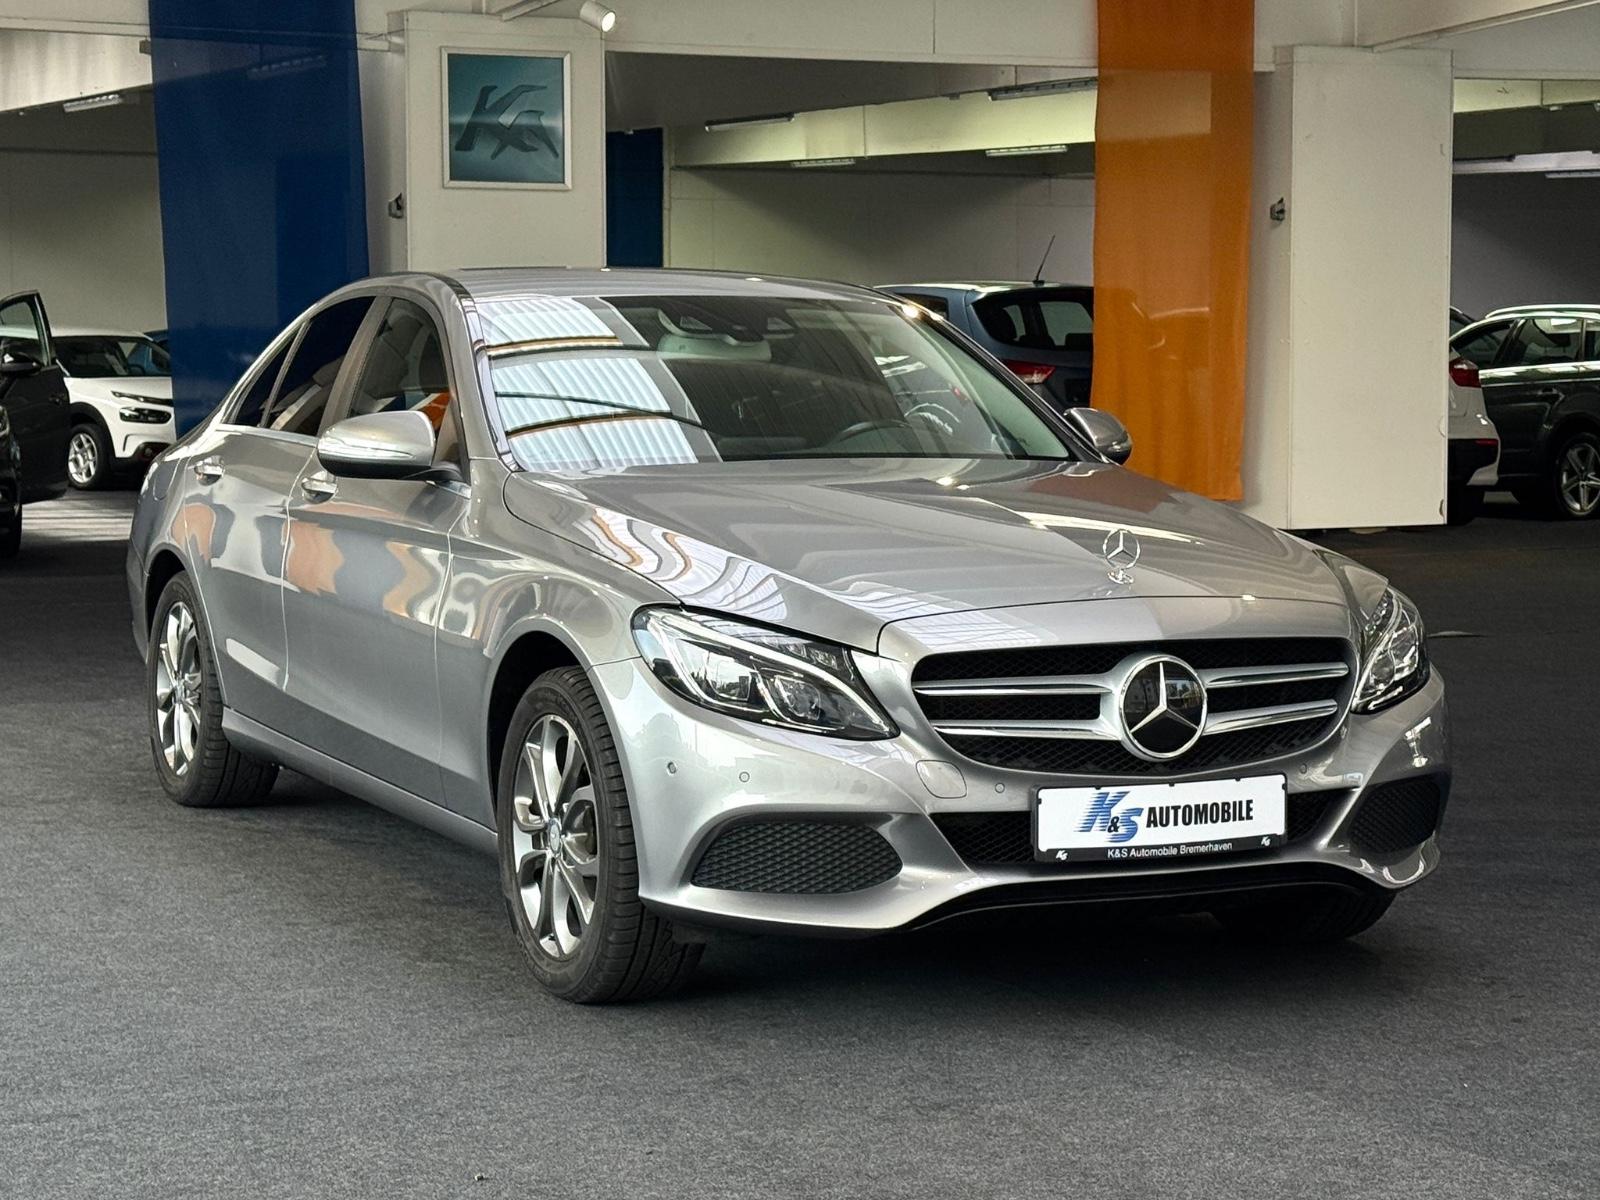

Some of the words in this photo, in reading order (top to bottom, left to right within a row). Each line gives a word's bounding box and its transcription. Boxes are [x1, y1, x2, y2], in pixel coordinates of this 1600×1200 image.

[1074, 791, 1144, 843] K&S
[1146, 799, 1254, 829] AUTOMOBILE
[1107, 848, 1128, 858] K&S
[1129, 845, 1178, 858] Automobile
[1179, 842, 1233, 855] Bremerhaven
